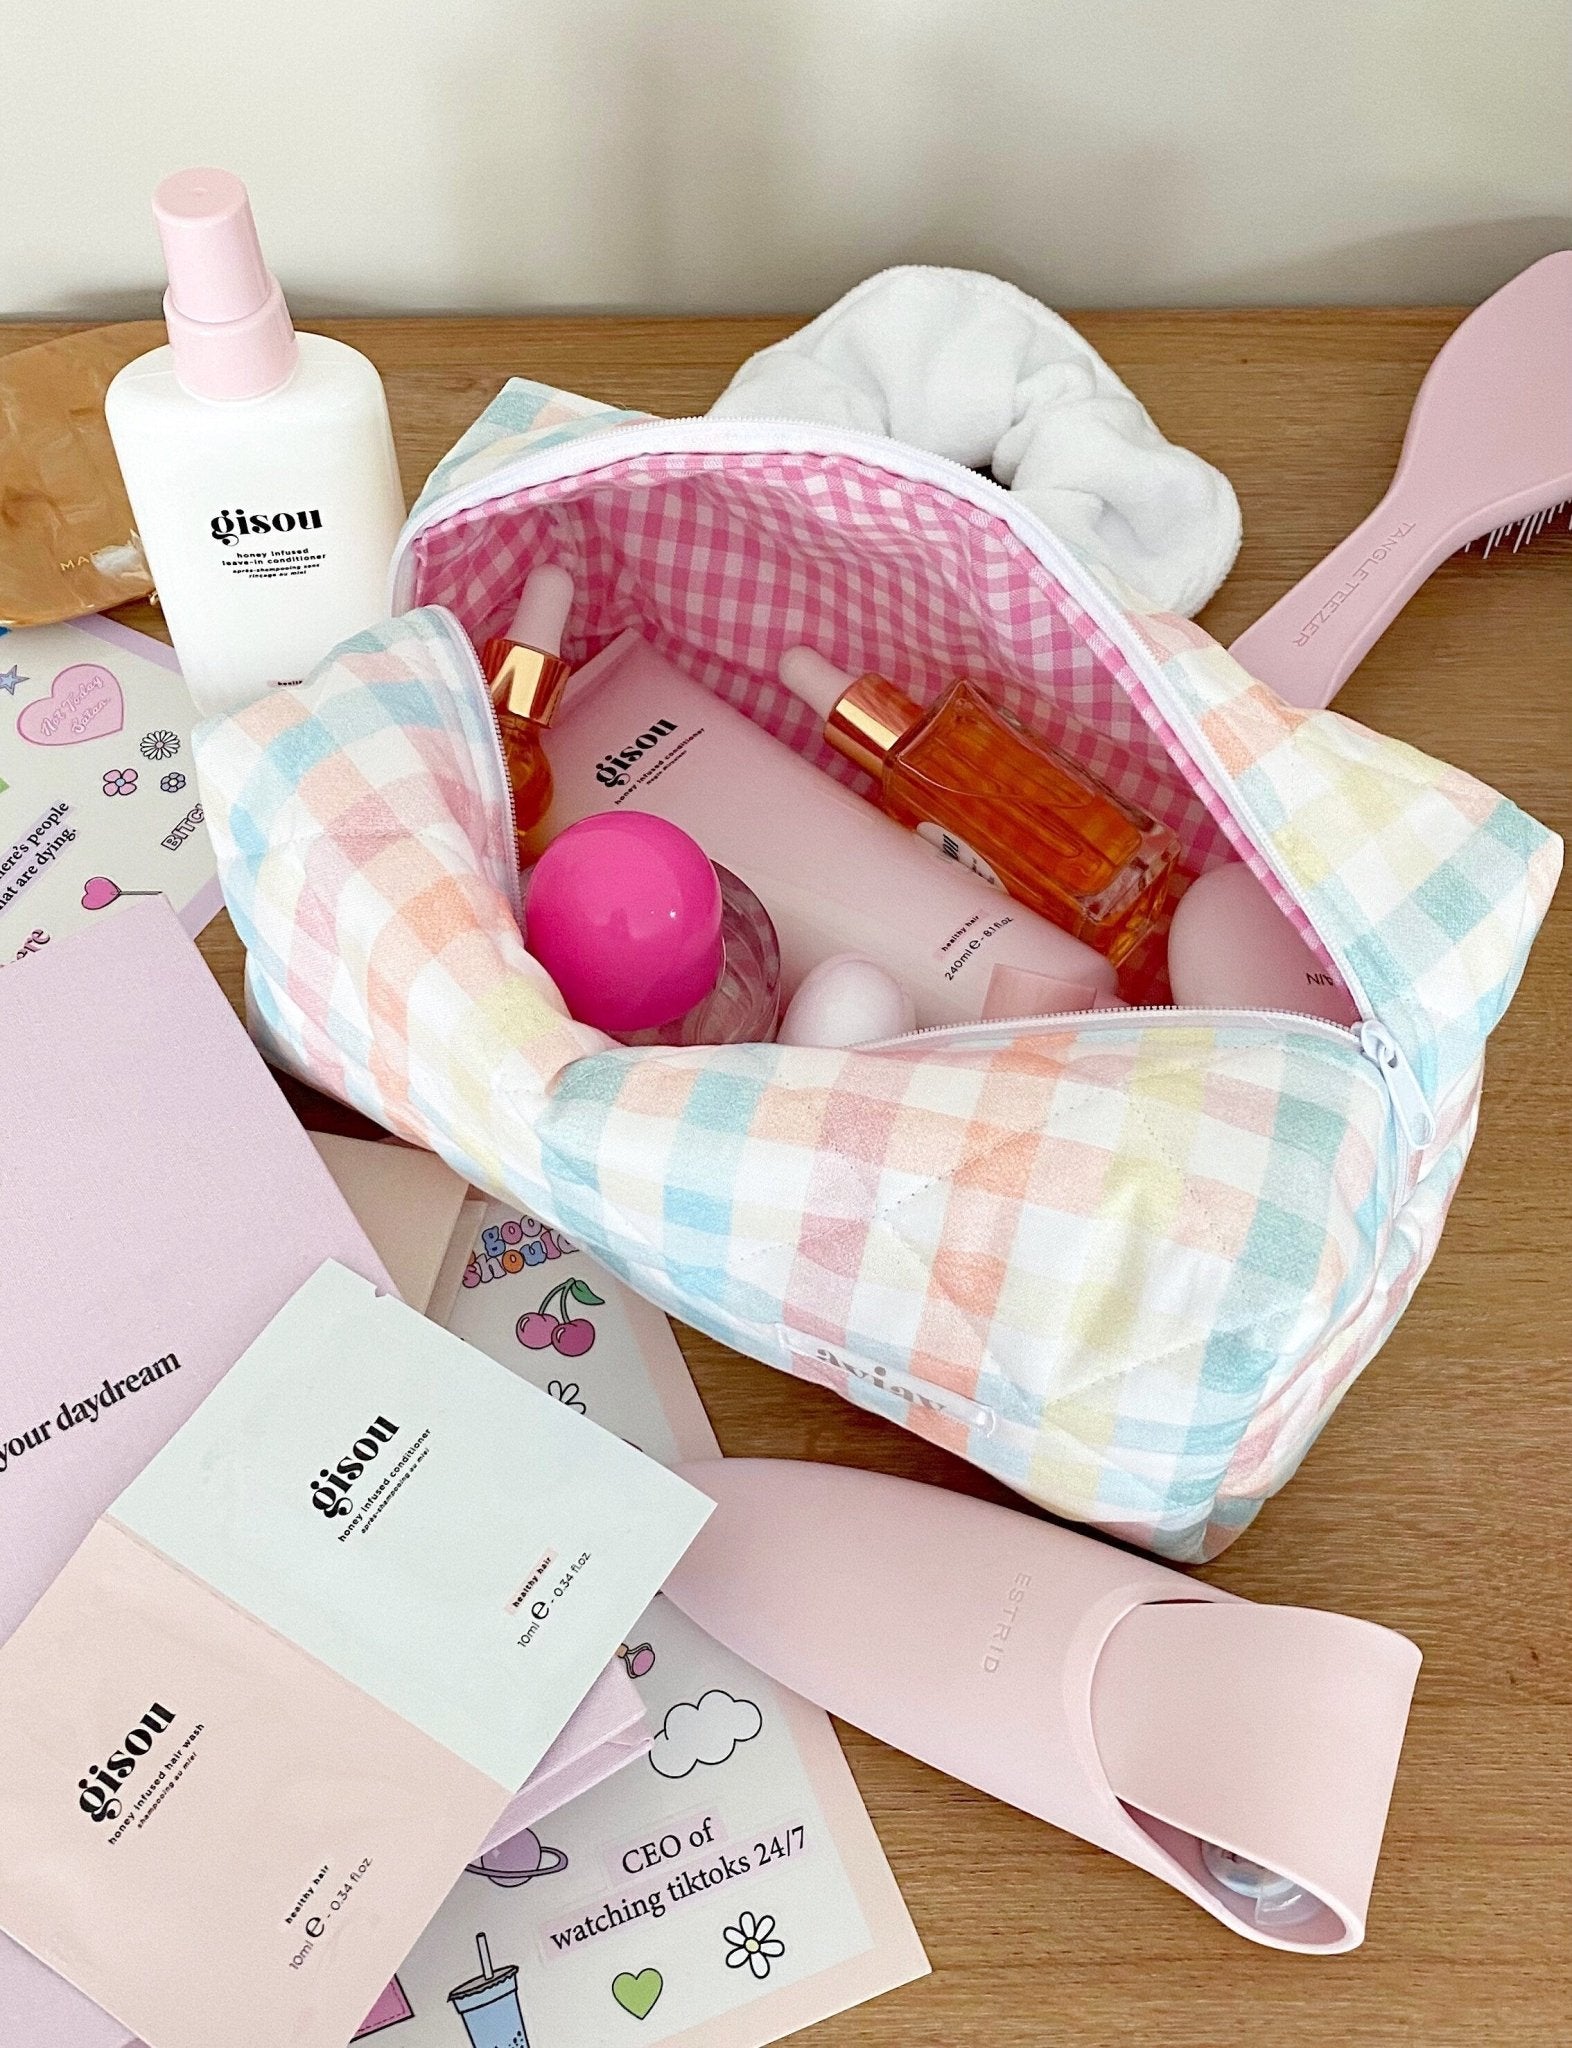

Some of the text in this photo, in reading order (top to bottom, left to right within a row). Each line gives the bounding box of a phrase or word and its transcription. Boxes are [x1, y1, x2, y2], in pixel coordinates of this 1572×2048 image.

[211, 509, 322, 546] gisou
[267, 554, 326, 565] conditioner
[271, 548, 309, 557] infused
[41, 676, 104, 737] Not Today
[595, 719, 678, 788] gisou
[615, 728, 705, 805] honey infused conditioner
[27, 802, 69, 847] people
[161, 803, 204, 851] BITC
[16, 865, 38, 887] are
[941, 915, 979, 952] healthy hair
[945, 949, 973, 981] 240ml
[0, 1353, 181, 1472] your daydream
[310, 1415, 400, 1518] gisou
[338, 1429, 431, 1542] honey infused conditioner
[512, 1557, 551, 1608] healthy hair
[517, 1621, 540, 1647] 10ml
[554, 1573, 574, 1597] 0.34
[984, 1572, 1031, 1673] ESTRID
[78, 1702, 176, 1823] gisou
[108, 1724, 205, 1845] honey infused hair wash
[137, 1752, 197, 1829] shampooing au miel
[622, 1817, 715, 1874] CEO of
[285, 1865, 329, 1924] healthy hair
[550, 1825, 805, 1950] watching tiktoks 24/7
[289, 1940, 314, 1970] 10ml
[330, 1883, 352, 1911] 0.34
